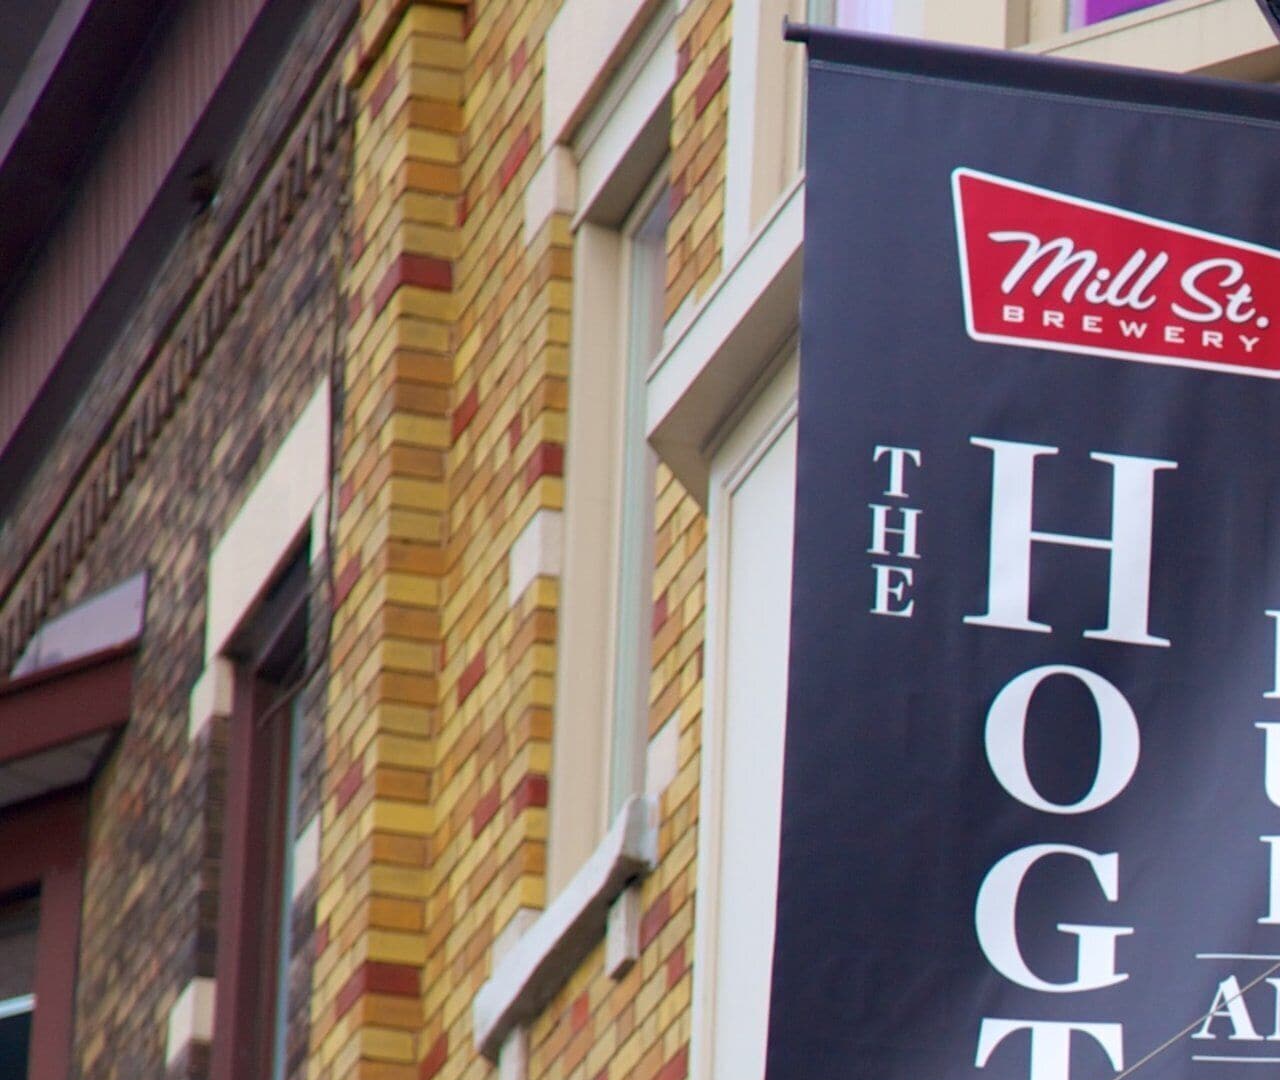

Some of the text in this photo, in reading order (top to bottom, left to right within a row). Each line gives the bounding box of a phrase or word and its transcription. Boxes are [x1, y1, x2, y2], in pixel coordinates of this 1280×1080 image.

[987, 231, 1270, 330] Mill St.
[1002, 304, 1260, 353] BREWERY
[867, 445, 922, 618] THE
